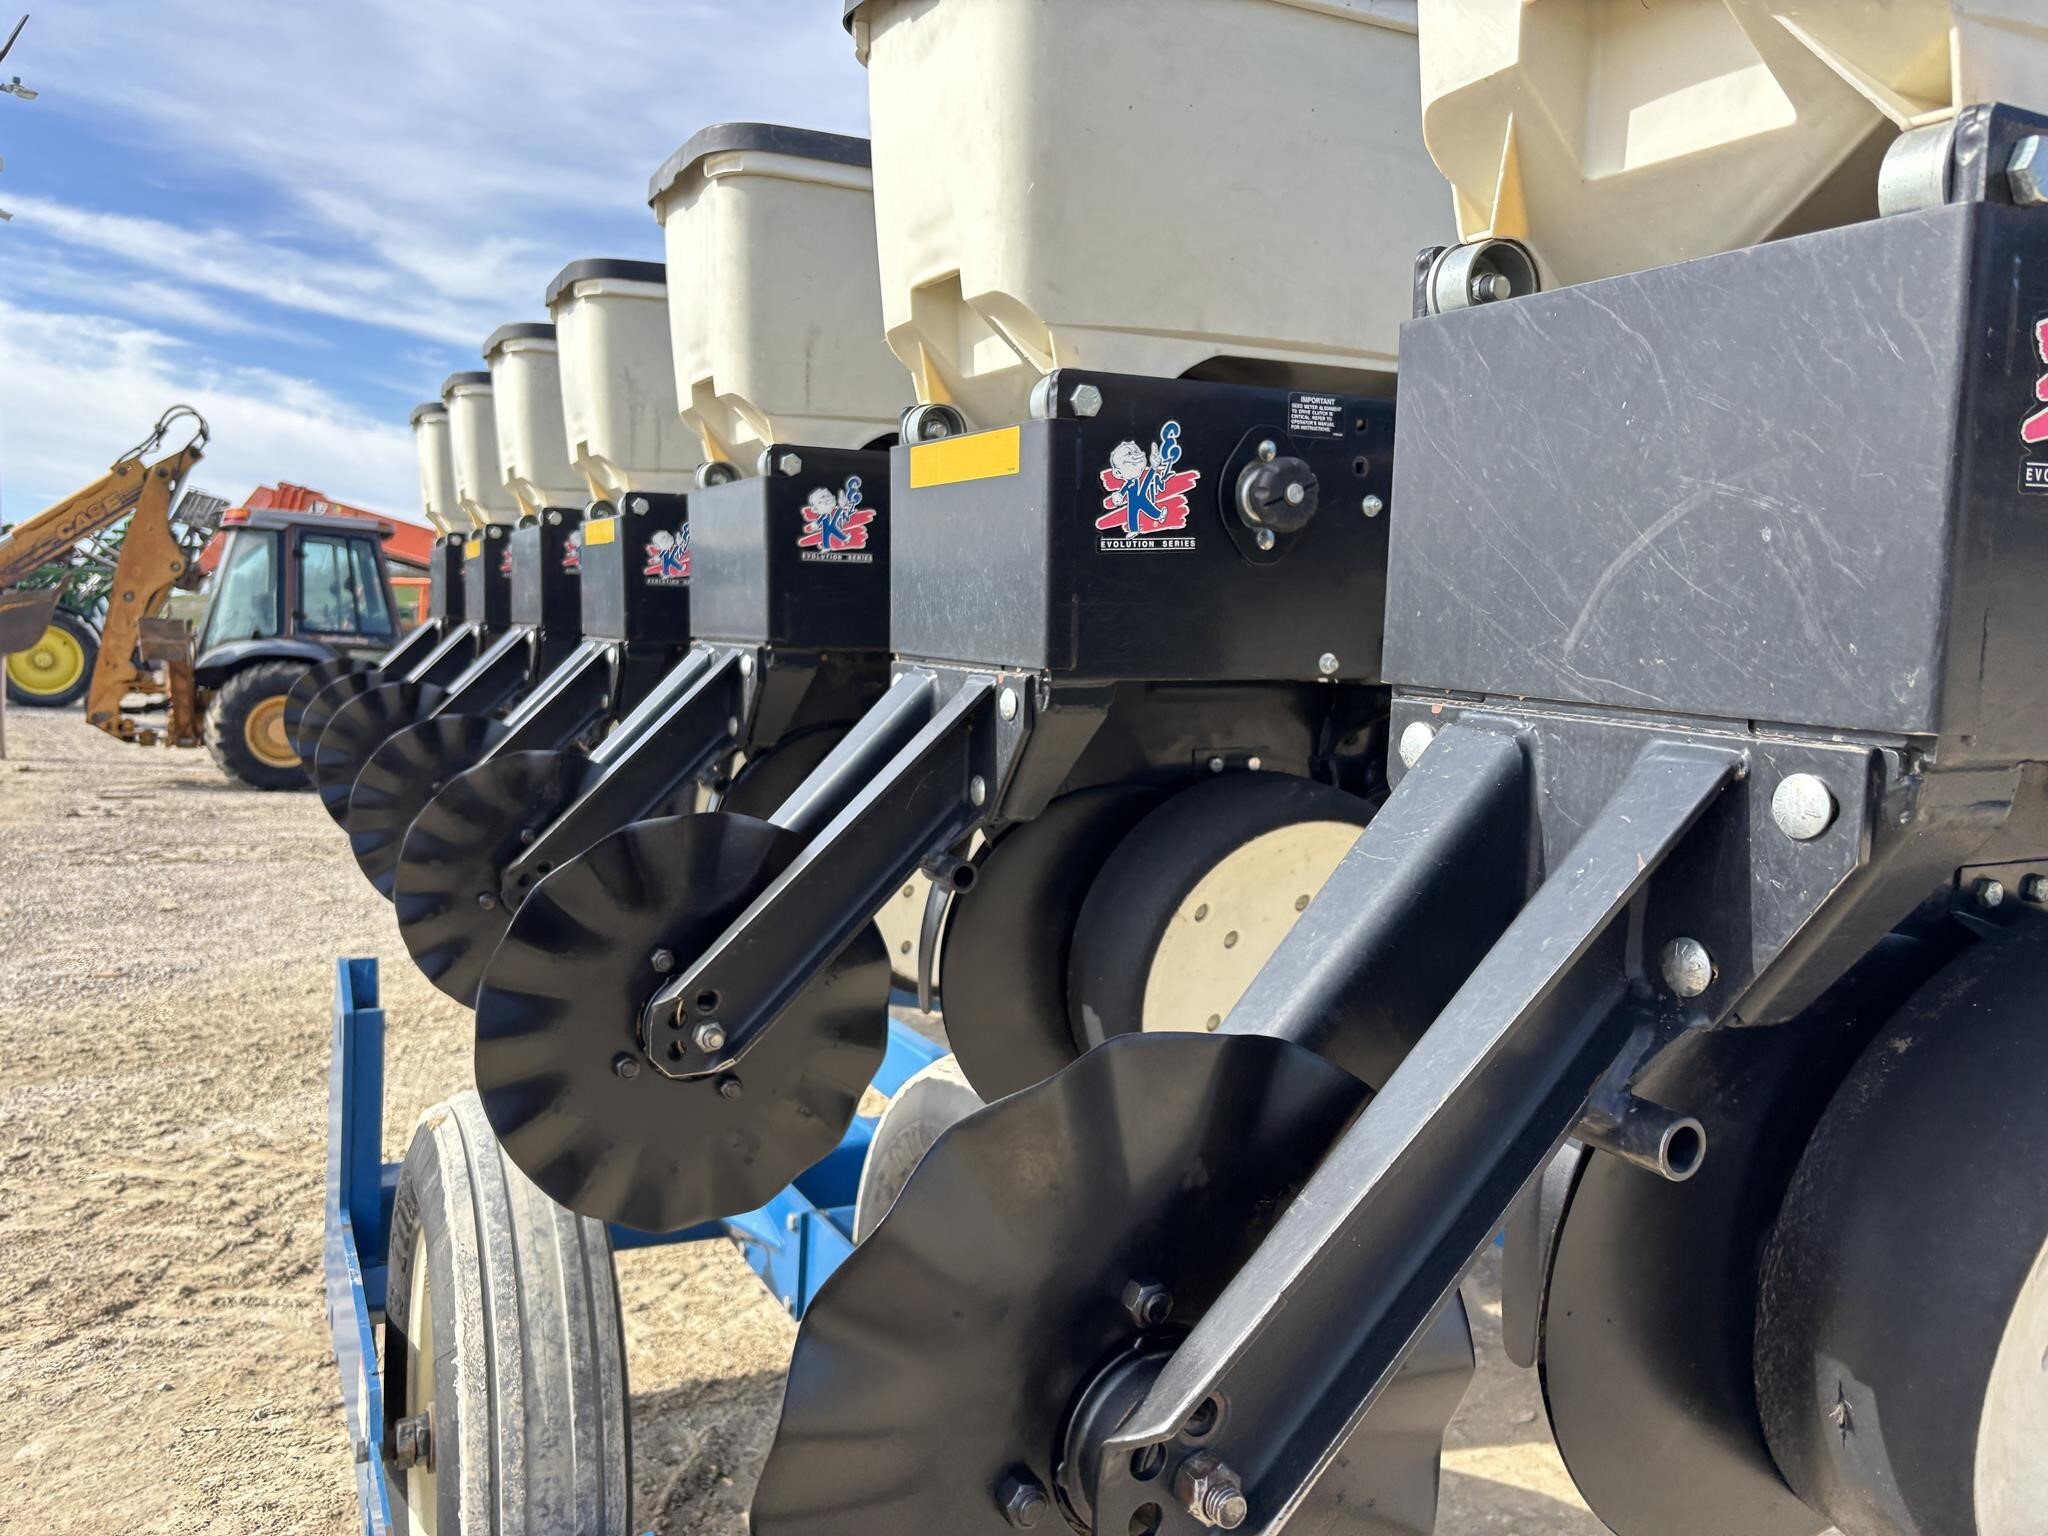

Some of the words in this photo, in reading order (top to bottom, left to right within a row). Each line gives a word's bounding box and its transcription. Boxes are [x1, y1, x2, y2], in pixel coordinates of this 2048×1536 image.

[1301, 396, 1335, 405] IMPORTANT
[56, 494, 123, 540] CASE
[1100, 540, 1155, 549] EVOLUTION
[1162, 540, 1196, 548] SERIES
[802, 552, 842, 561] EVOLUTION
